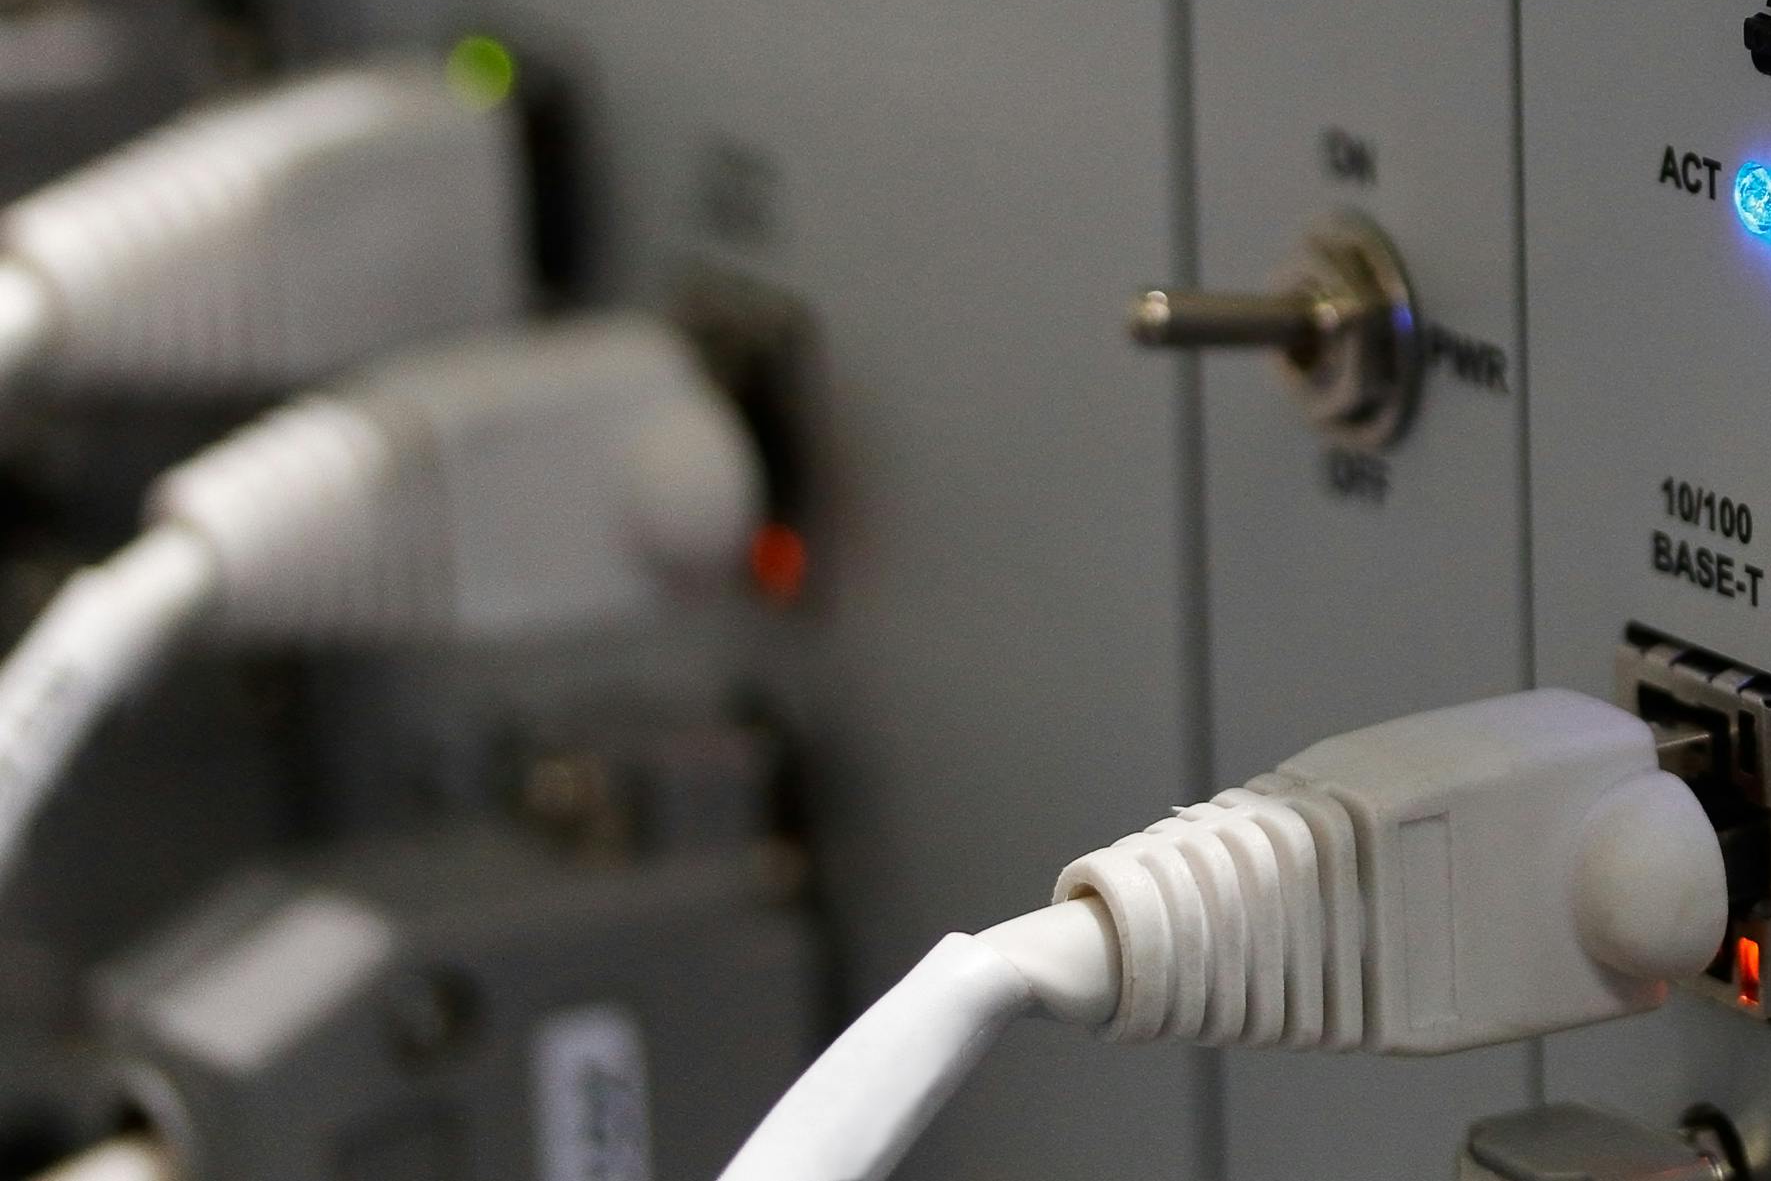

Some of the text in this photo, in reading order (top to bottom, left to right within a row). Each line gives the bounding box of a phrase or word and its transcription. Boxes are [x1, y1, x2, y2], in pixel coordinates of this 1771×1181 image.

[1325, 126, 1377, 184] ON
[1658, 144, 1723, 201] ACT
[1424, 321, 1510, 394] PWR
[1661, 475, 1753, 545] 10/100
[1653, 529, 1765, 608] BASE-T
